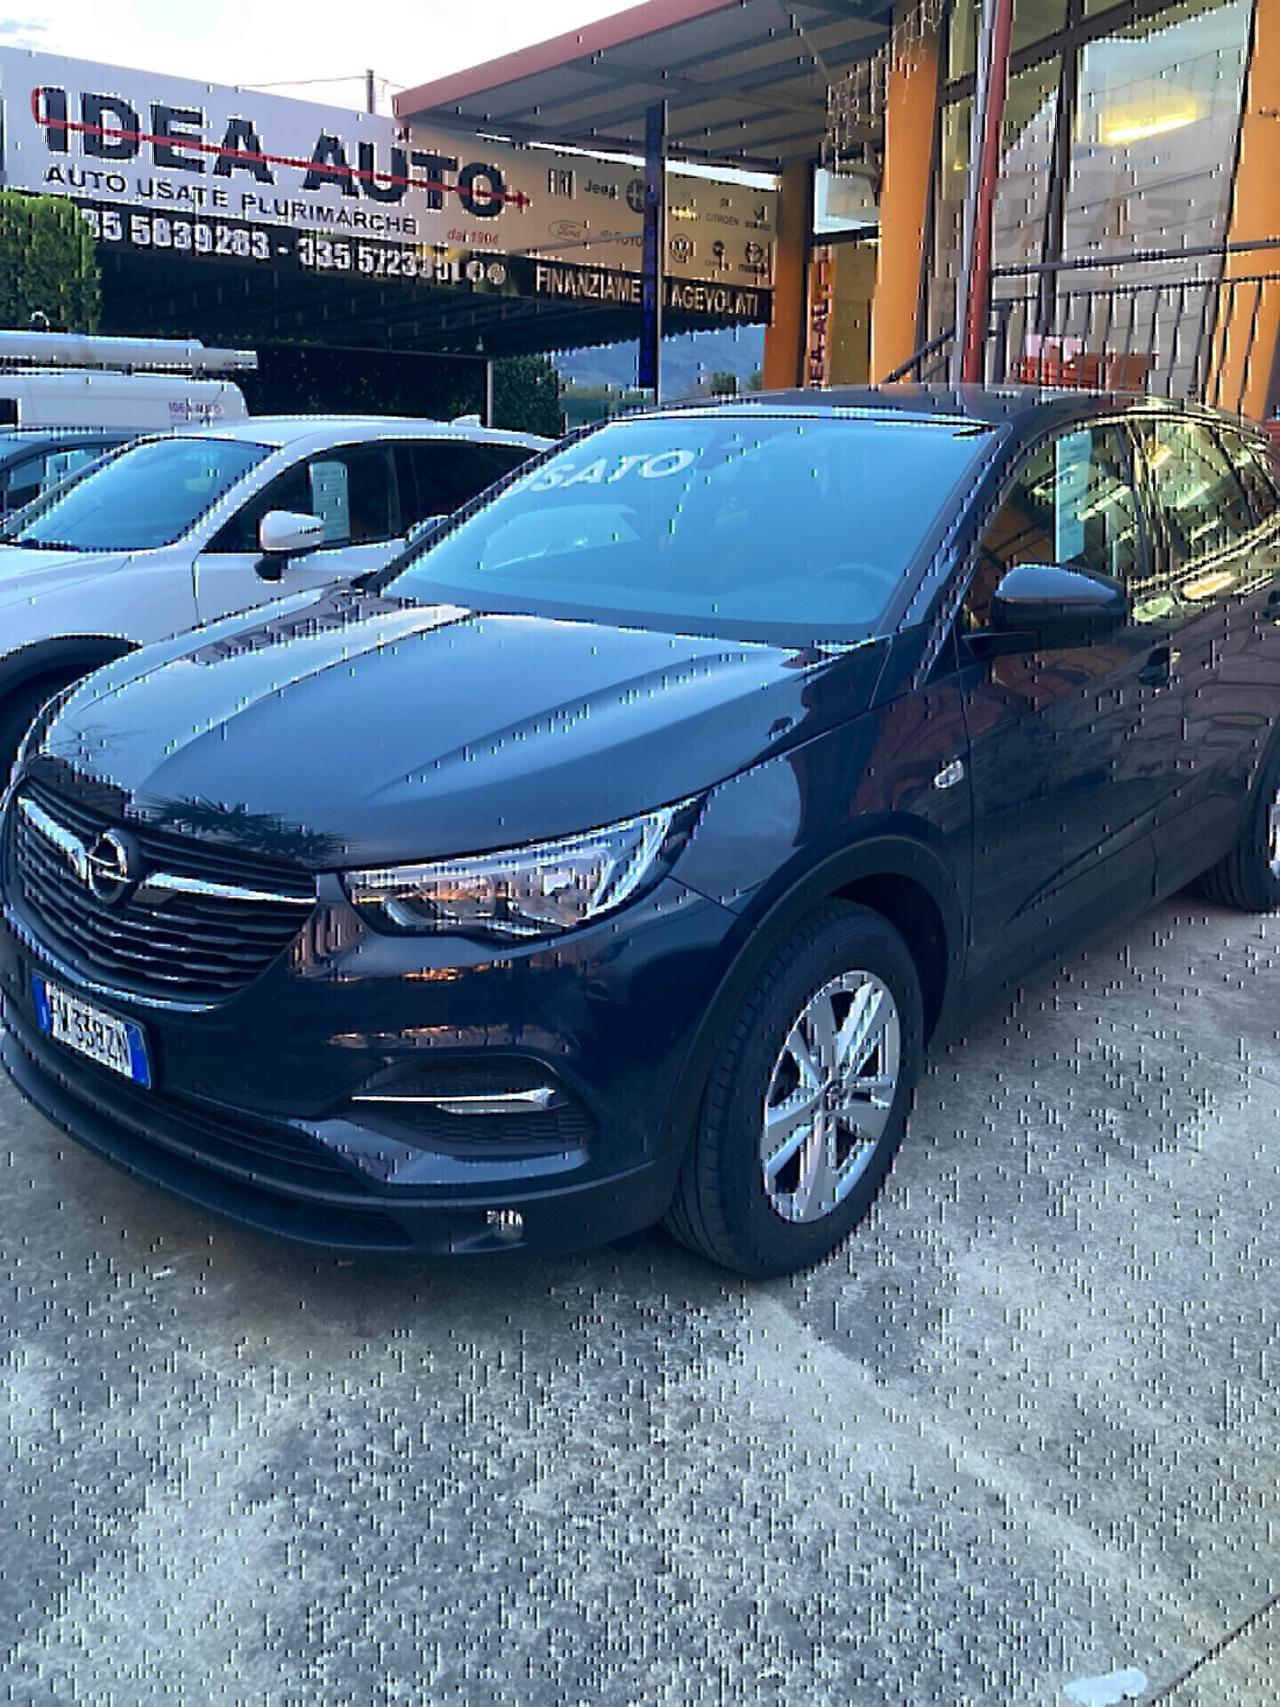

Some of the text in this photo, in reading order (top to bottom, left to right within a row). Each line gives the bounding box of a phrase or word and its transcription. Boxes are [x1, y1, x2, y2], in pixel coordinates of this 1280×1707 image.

[43, 87, 507, 217] IDEA AUTO
[46, 166, 417, 236] AUTO USATE PLURIMARCHE
[584, 180, 617, 199] Jeep
[672, 283, 757, 316] AGEVOLATI
